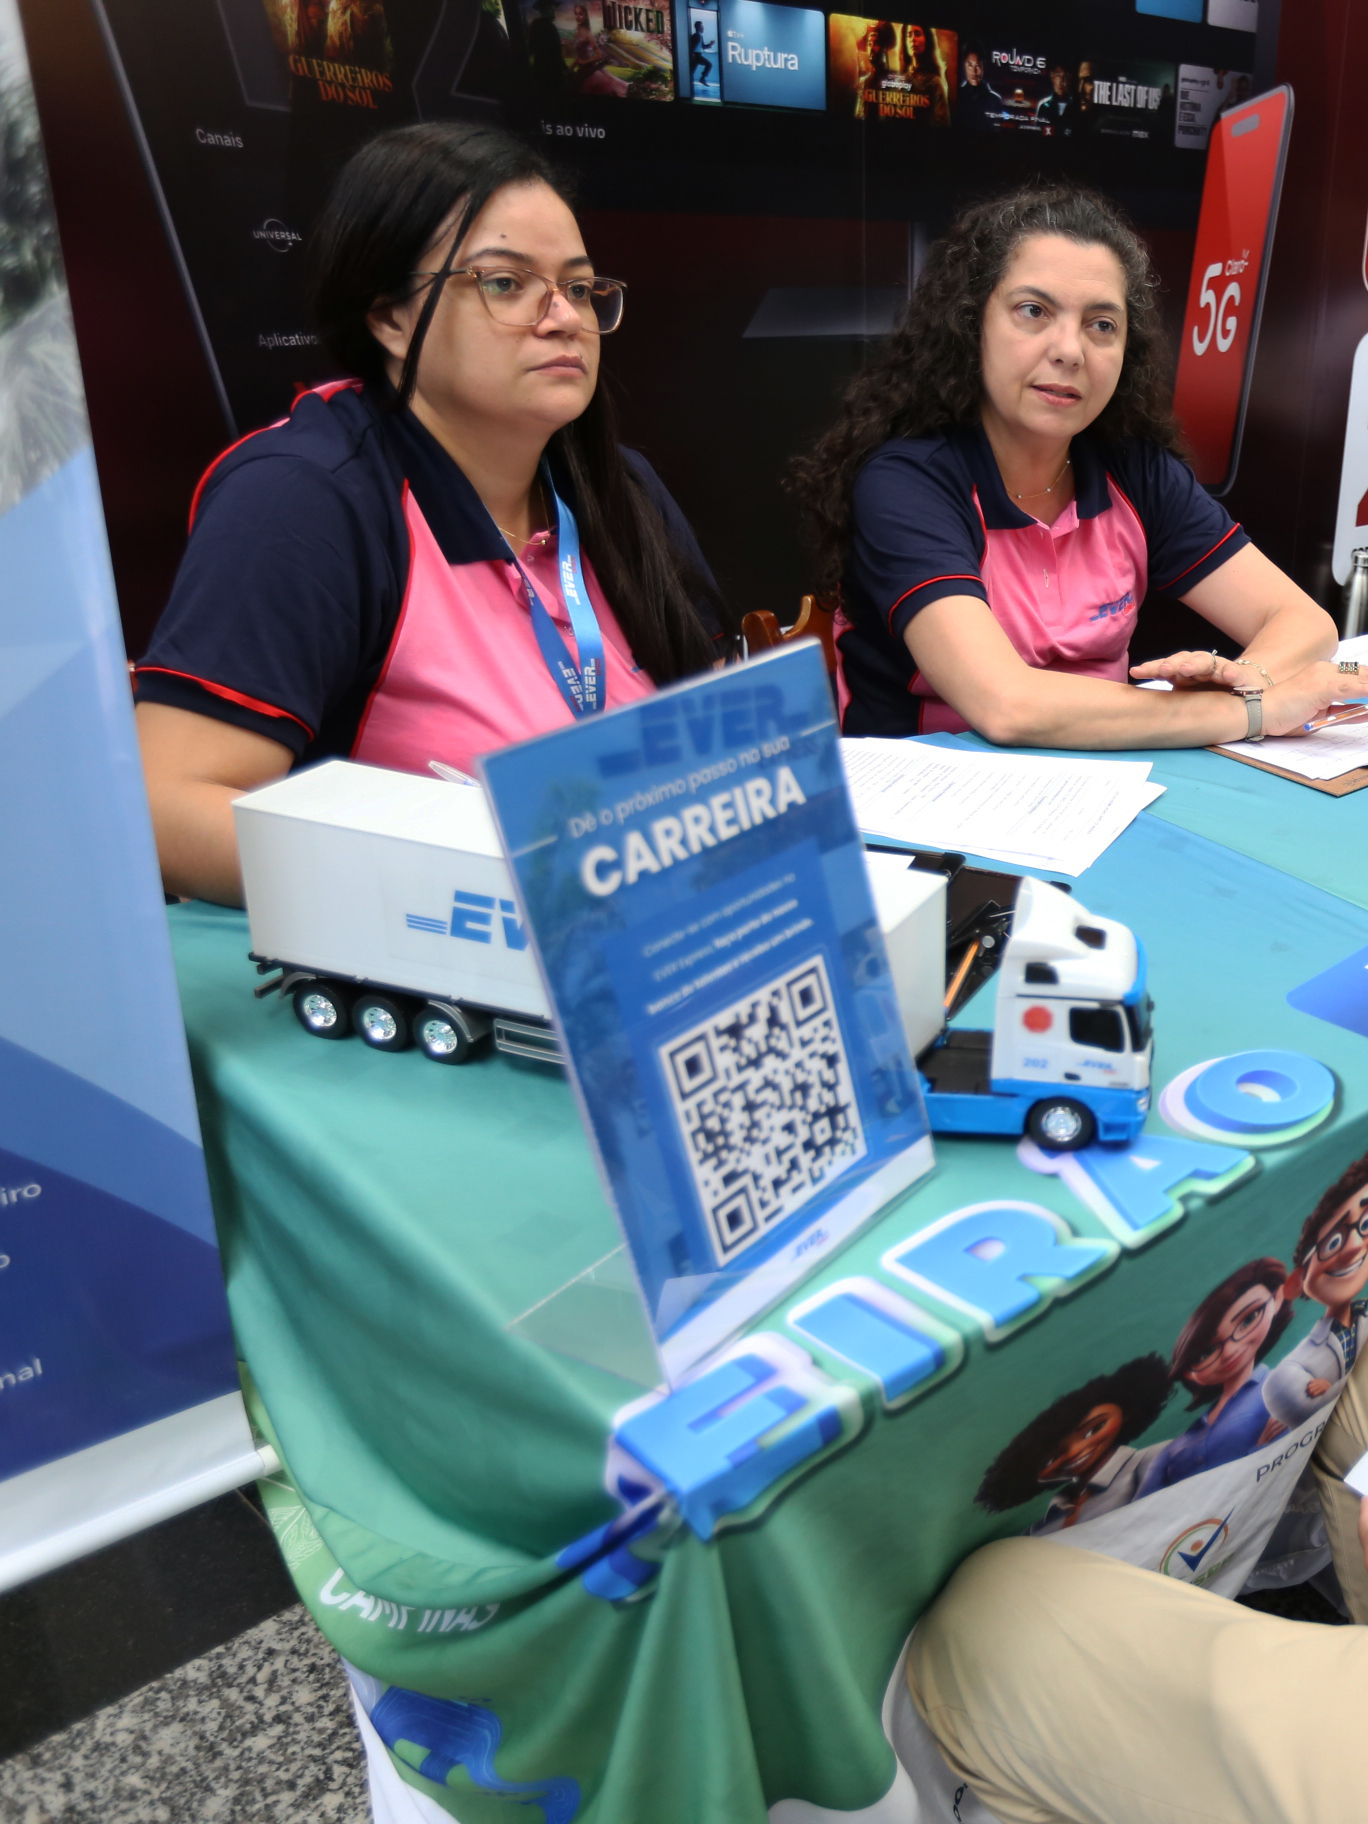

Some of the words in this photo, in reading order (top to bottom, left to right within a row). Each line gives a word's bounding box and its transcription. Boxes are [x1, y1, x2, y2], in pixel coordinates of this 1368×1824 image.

[727, 42, 799, 71] Ruptura
[1036, 57, 1046, 69] 6
[1093, 80, 1111, 104] THE
[1112, 82, 1135, 107] LAST
[1136, 86, 1147, 109] OF
[1148, 87, 1161, 110] US
[196, 128, 244, 148] Canais
[556, 125, 573, 136] ao
[577, 124, 606, 138] vivo
[253, 230, 302, 241] UNIVERSAL
[1193, 262, 1241, 356] 5G
[584, 666, 598, 702] EVER
[569, 813, 597, 839] Dê
[600, 809, 613, 827] o
[616, 778, 687, 828] próximo
[689, 756, 738, 799] passo
[741, 747, 761, 768] na
[762, 736, 790, 759] sua
[581, 767, 807, 897] CARREIRA
